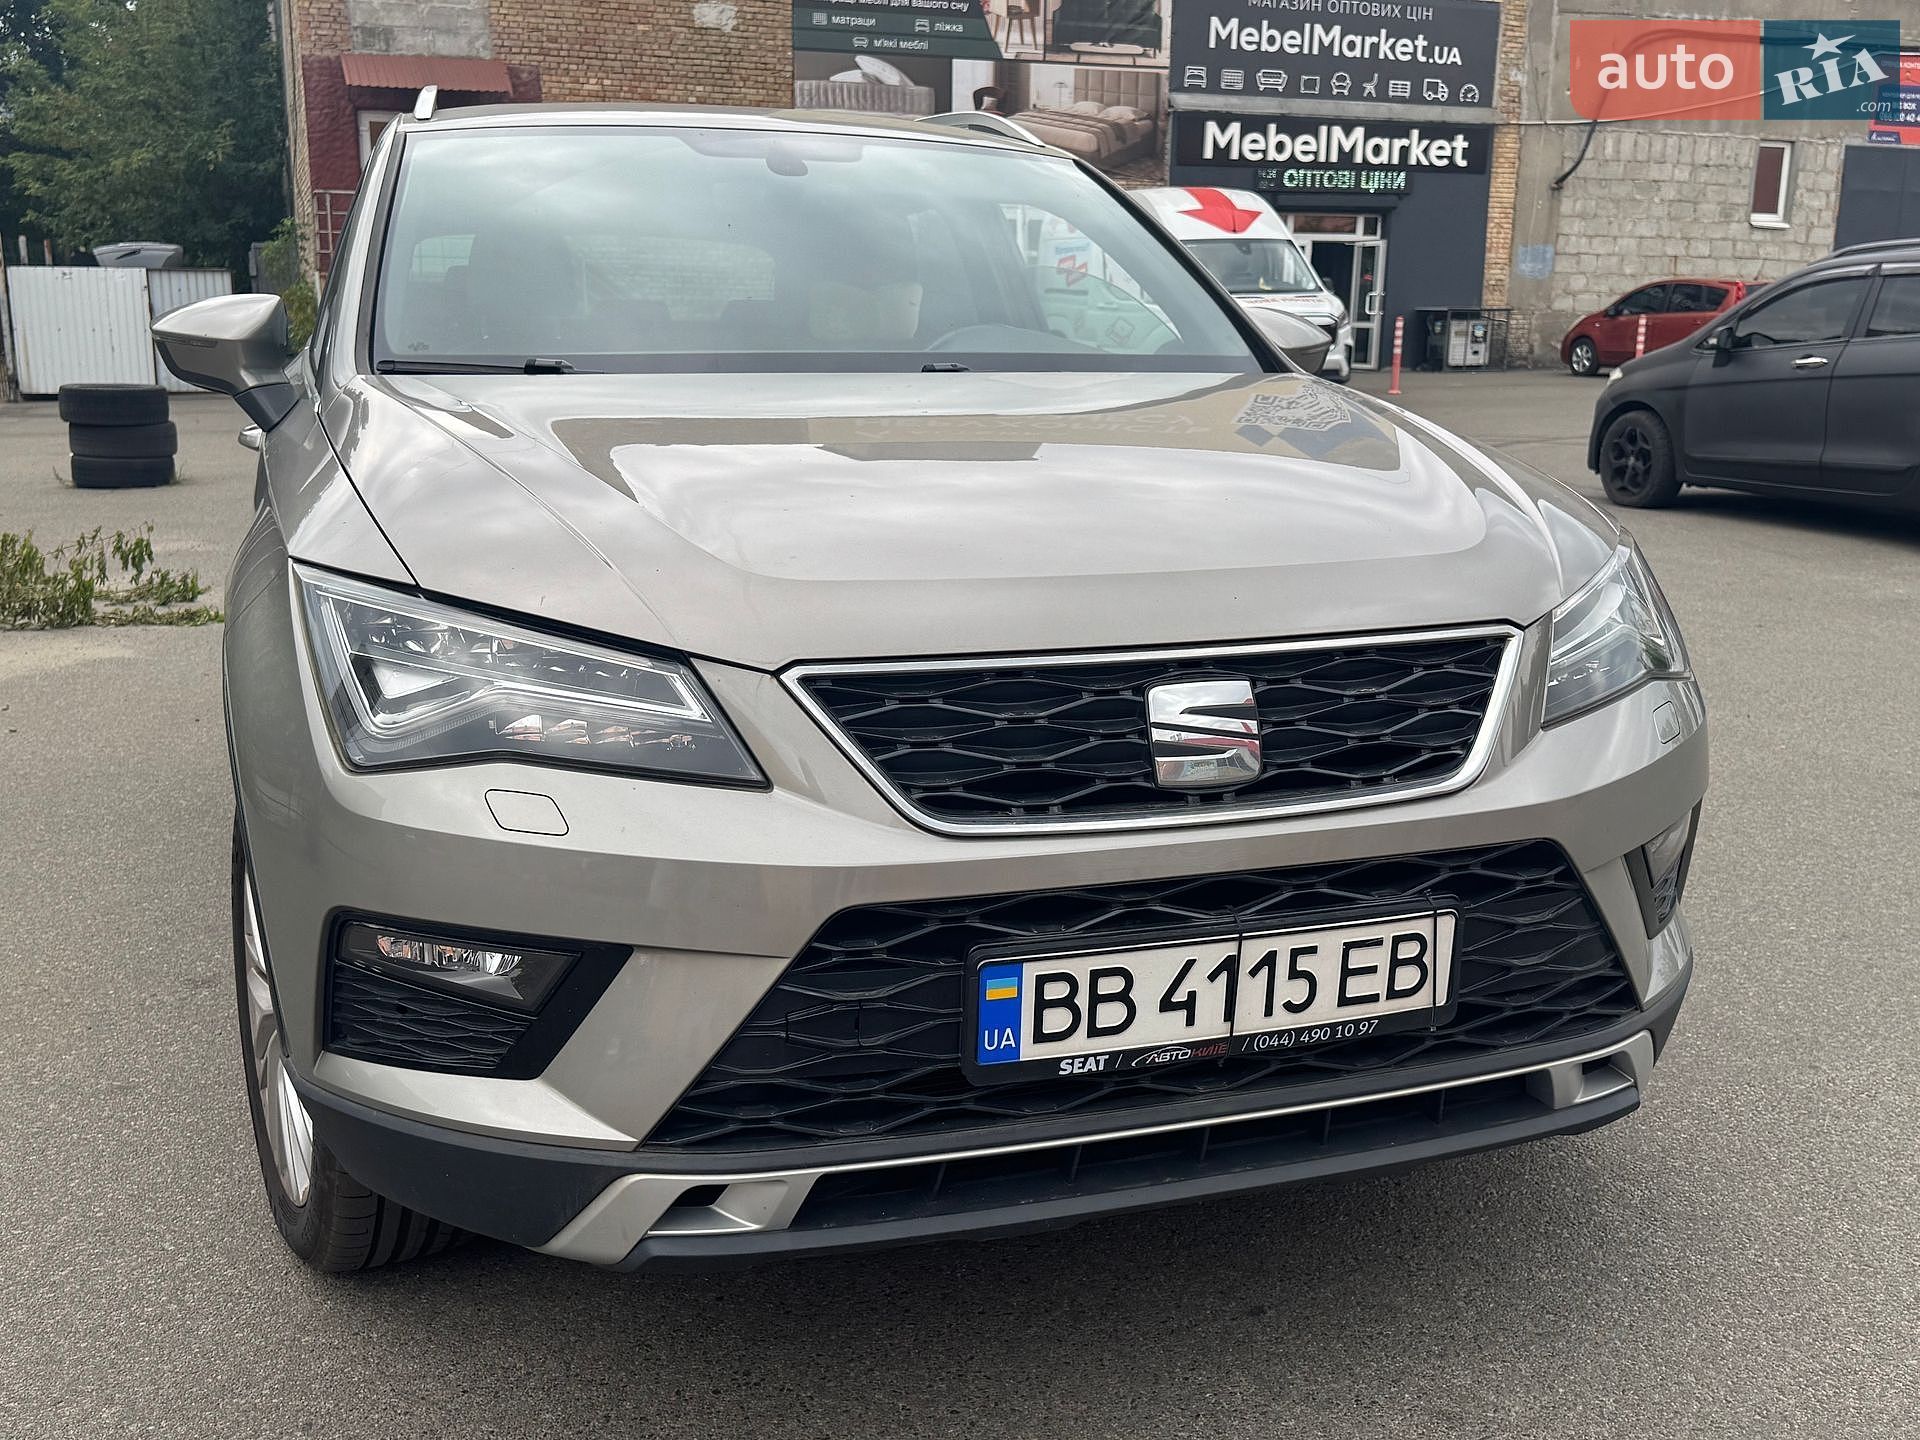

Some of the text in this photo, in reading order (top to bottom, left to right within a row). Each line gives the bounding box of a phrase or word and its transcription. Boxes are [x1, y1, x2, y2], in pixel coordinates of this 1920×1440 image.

[911, 0, 949, 9] вашого
[950, 2, 969, 12] сну
[1248, 0, 1434, 21] МАГАЗИН ОПТОВИХ ЦІН
[831, 16, 876, 27] матраци
[934, 22, 964, 32] ліжка
[899, 40, 929, 50] меблі
[1208, 16, 1462, 66] MebelMarket.UA
[1202, 120, 1469, 167] MebelMarket
[1283, 169, 1356, 187] ОПТОВІ
[1360, 169, 1407, 193] ЦІНИ
[1033, 932, 1428, 1044] BB 4115 EB
[984, 1027, 1016, 1050] UA
[1058, 1053, 1109, 1076] SEAT
[1253, 1030, 1295, 1052] (044)
[1300, 1028, 1330, 1044] 490
[1336, 1023, 1354, 1039] 10
[1358, 1019, 1379, 1035] 97
